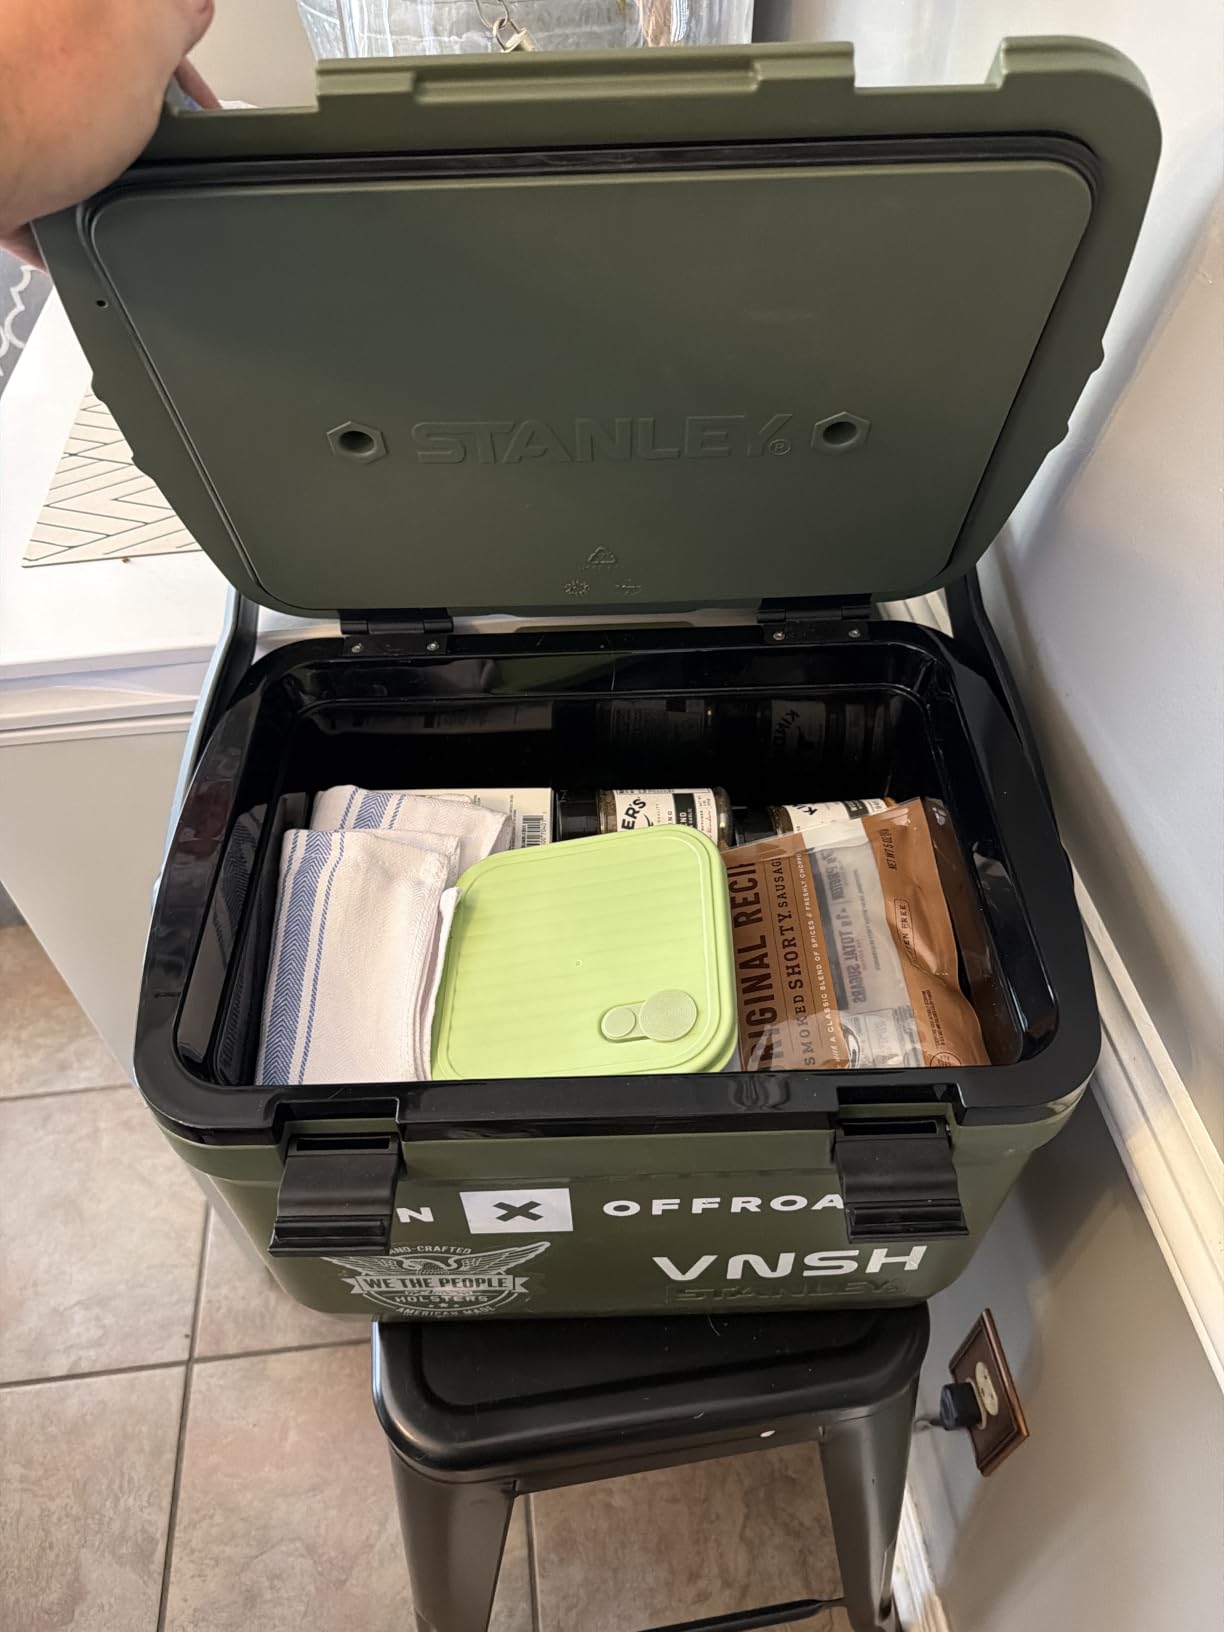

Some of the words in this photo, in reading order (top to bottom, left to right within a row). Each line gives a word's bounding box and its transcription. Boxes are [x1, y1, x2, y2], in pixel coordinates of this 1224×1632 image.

[411, 413, 793, 465] STANLEY
[801, 879, 811, 911] FRESHLY
[899, 903, 909, 929] FREE
[808, 920, 819, 948] SPICES
[813, 951, 821, 962] OF
[815, 964, 826, 991] BLEND
[821, 993, 834, 1033] CLASSIC
[792, 995, 816, 1066] SMOKED
[396, 1207, 435, 1223] N
[363, 1277, 394, 1289] WE
[396, 1277, 434, 1289] THE
[438, 1277, 509, 1289] PEOPLE
[394, 1295, 489, 1303] HOLSTERS
[395, 1307, 459, 1317] AMERICAN
